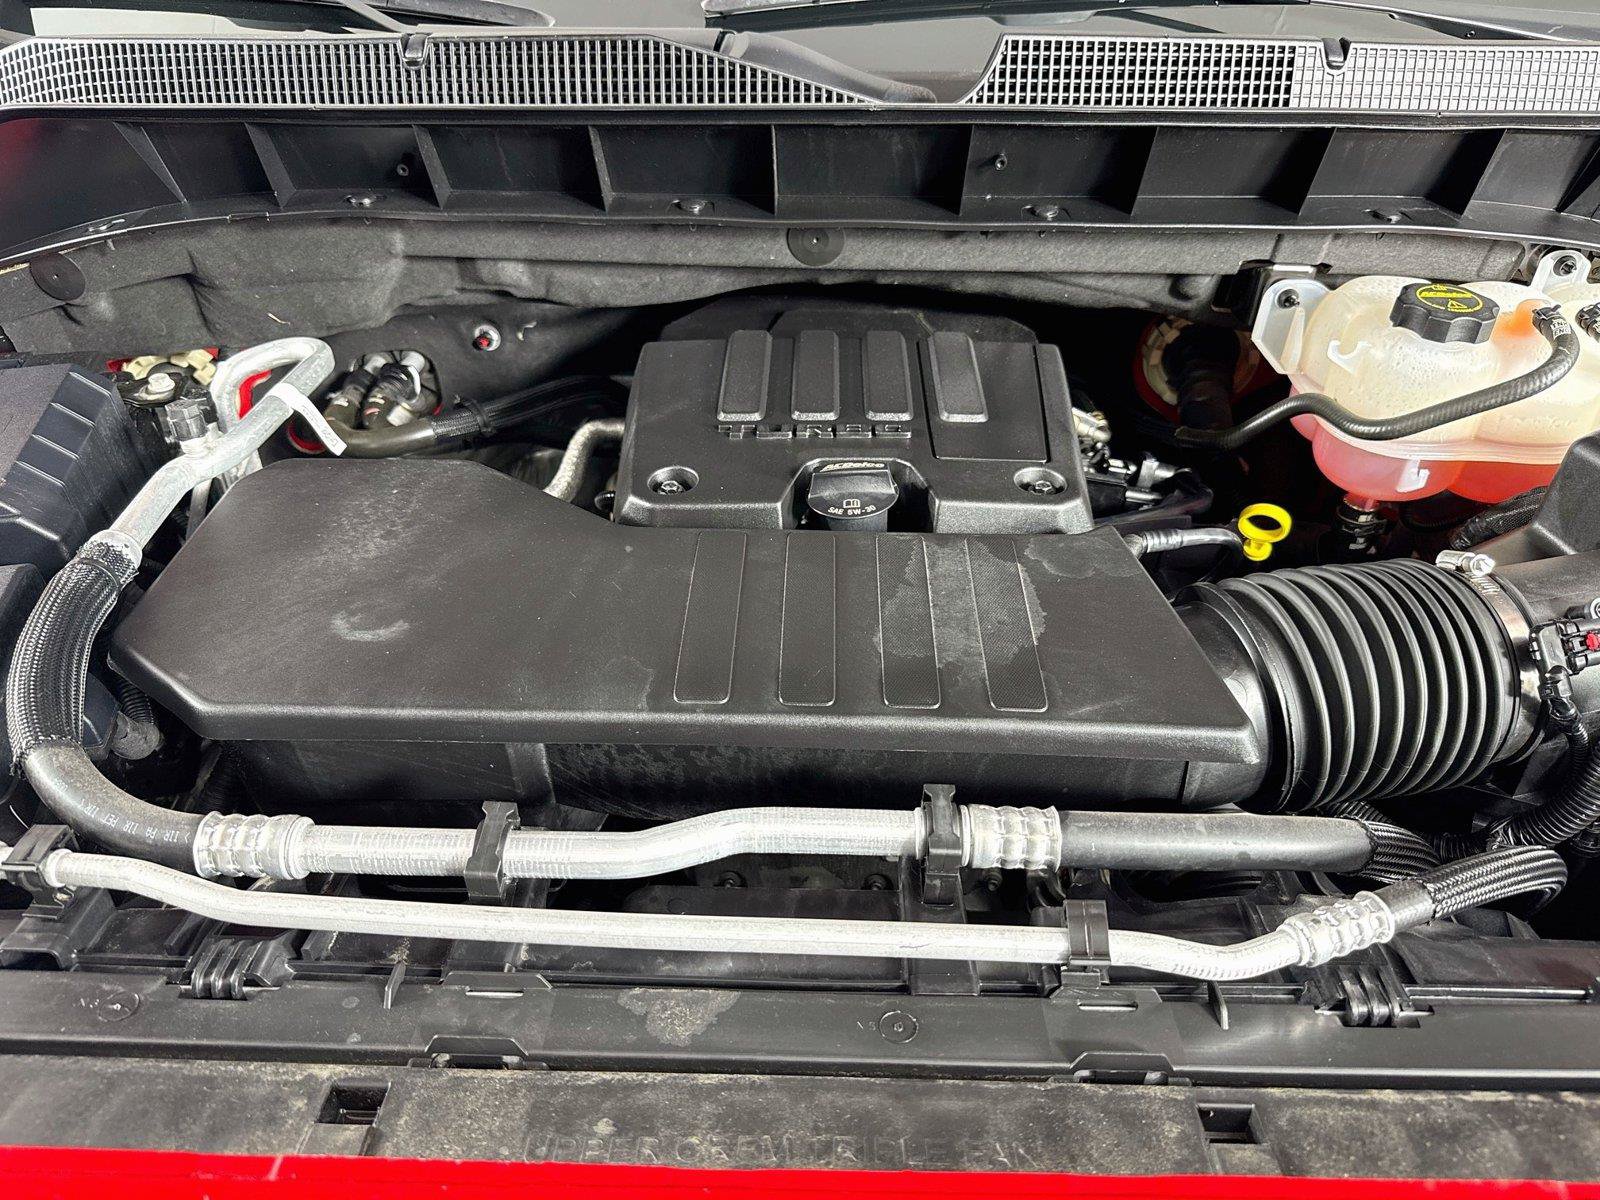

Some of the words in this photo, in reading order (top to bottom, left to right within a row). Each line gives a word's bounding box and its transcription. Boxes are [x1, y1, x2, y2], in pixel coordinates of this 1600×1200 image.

[717, 424, 912, 440] TURBO
[827, 506, 845, 515] SAE
[847, 504, 877, 516] 5W-30
